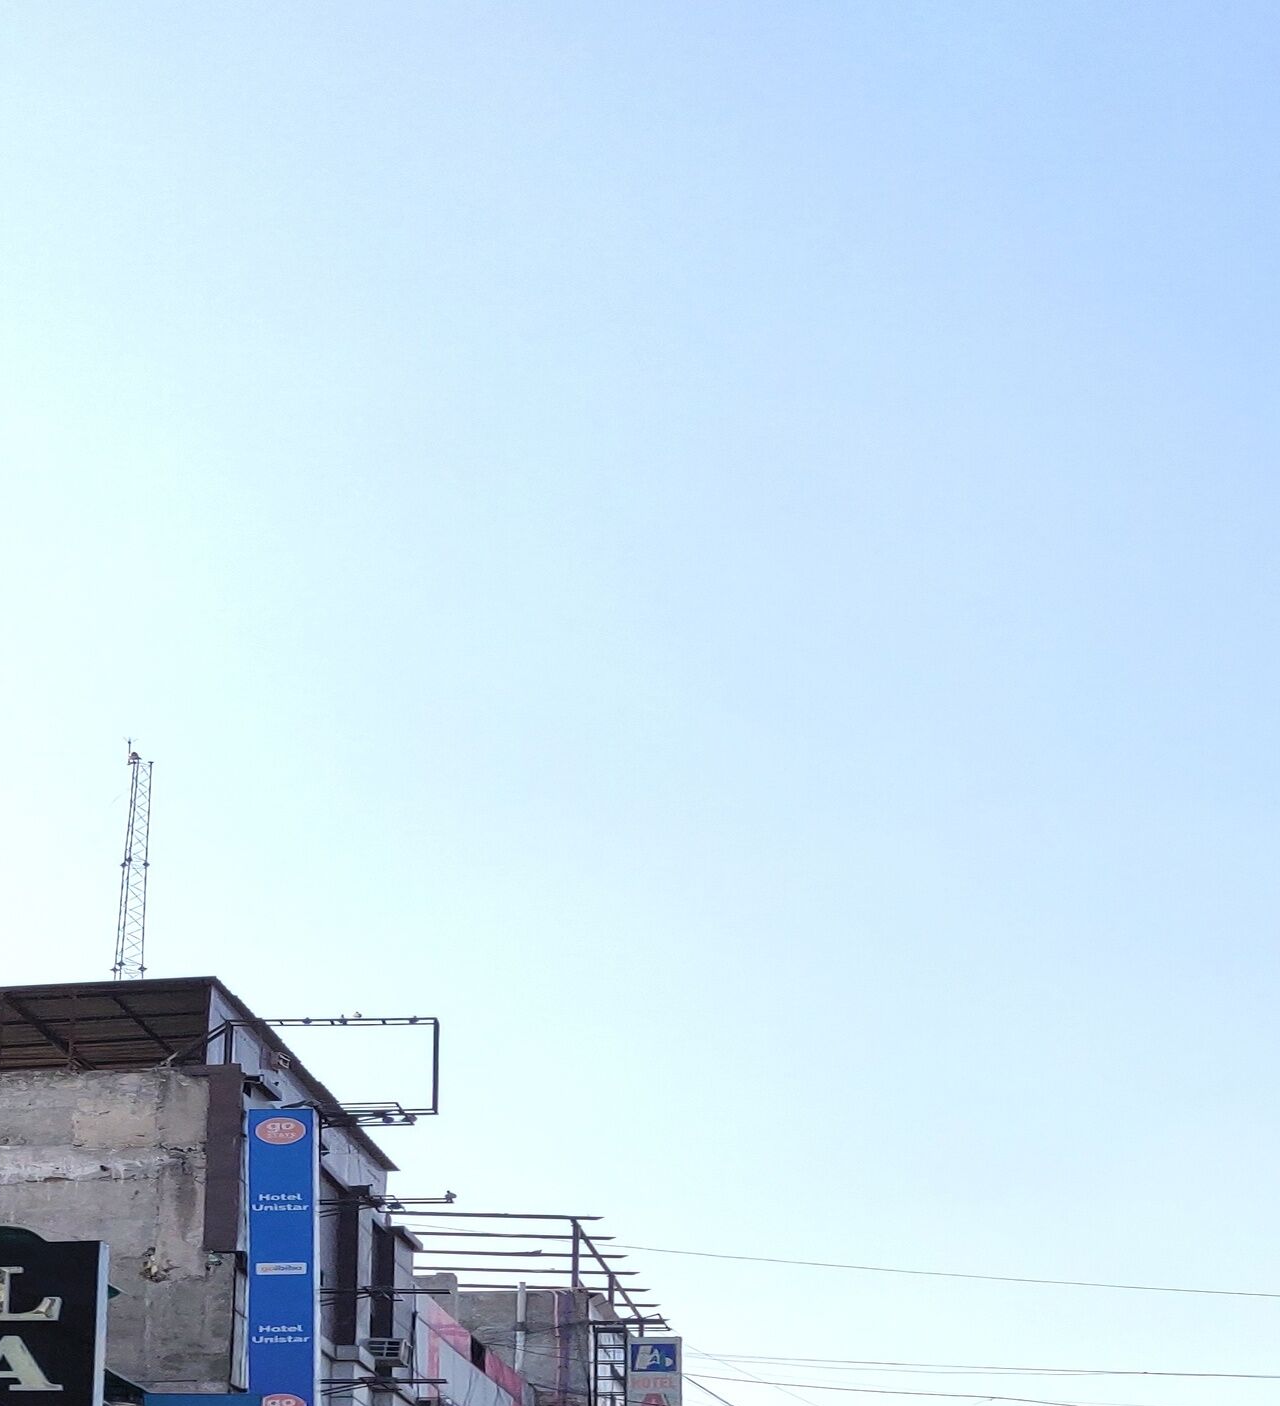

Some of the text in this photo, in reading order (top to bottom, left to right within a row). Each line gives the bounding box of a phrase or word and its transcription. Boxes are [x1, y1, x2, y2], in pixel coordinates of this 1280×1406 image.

[258, 1193, 303, 1201] Hotel
[251, 1203, 309, 1212] Unistar
[258, 1324, 304, 1333] Hotel
[251, 1335, 311, 1344] Unistar
